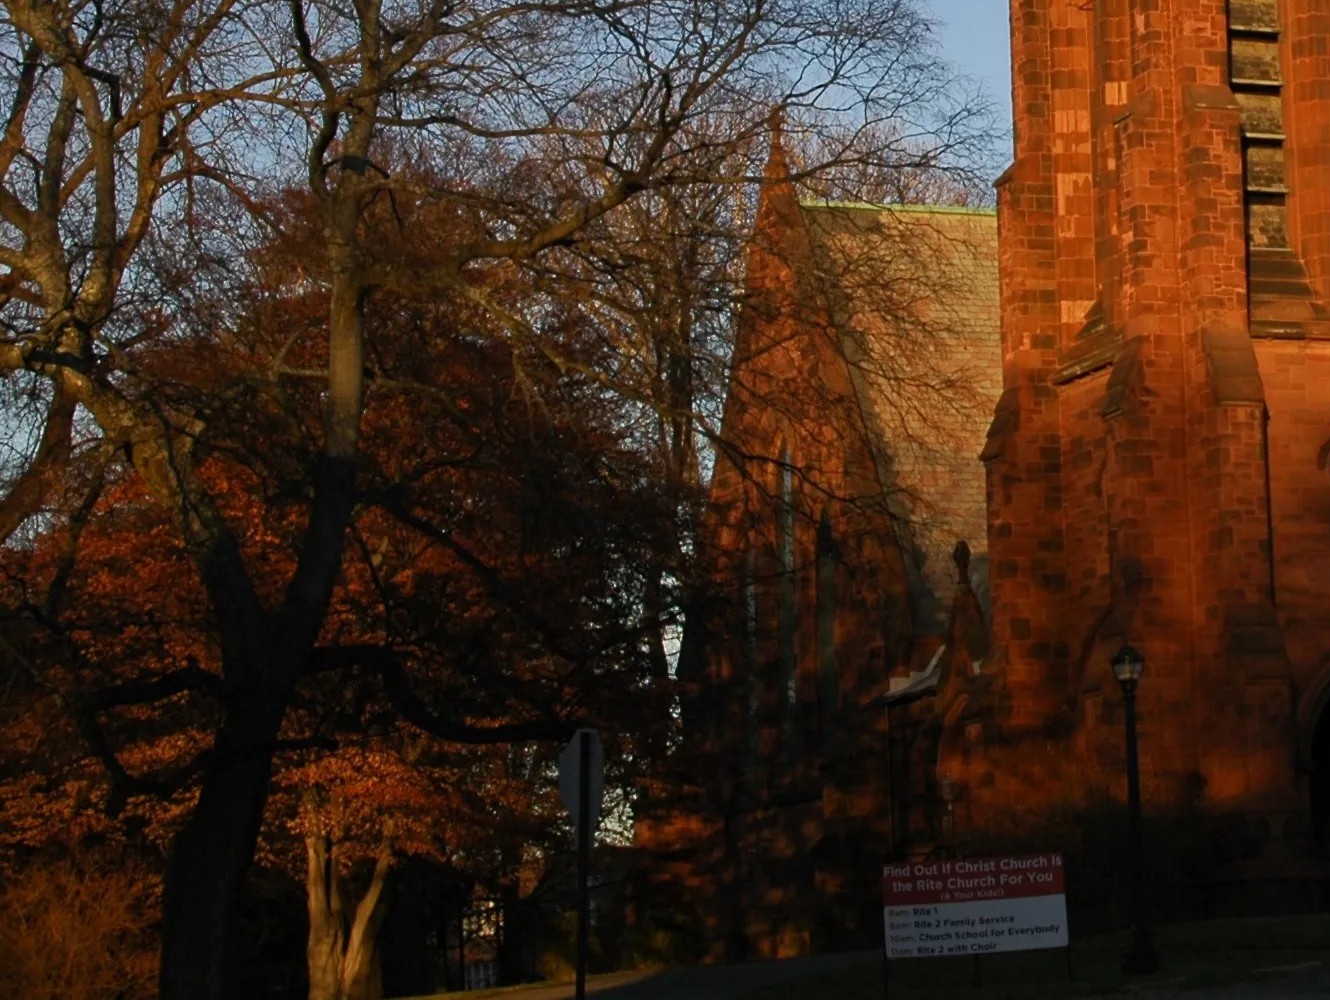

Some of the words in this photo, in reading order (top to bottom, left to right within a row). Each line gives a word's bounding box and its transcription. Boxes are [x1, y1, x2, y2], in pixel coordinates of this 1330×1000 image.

[883, 865, 910, 878] Find
[914, 864, 939, 876] Out
[955, 860, 996, 874] Christ
[999, 856, 1048, 871] Church
[892, 880, 913, 893] the
[916, 879, 943, 891] Rite
[947, 876, 996, 890] Church
[999, 873, 1024, 886] For
[1027, 871, 1053, 883] You
[912, 907, 930, 916] Rite
[933, 906, 938, 915] 1
[913, 919, 934, 929] Rite
[935, 919, 941, 928] 2
[943, 916, 976, 929] Family
[979, 915, 1015, 926] Service
[919, 932, 953, 942] Church
[955, 928, 988, 941] School
[990, 927, 1005, 938] for
[1007, 923, 1061, 938] Everybody
[917, 945, 936, 955] Rite
[938, 945, 944, 954] 2
[946, 944, 968, 953] with
[970, 942, 997, 952] Choir
